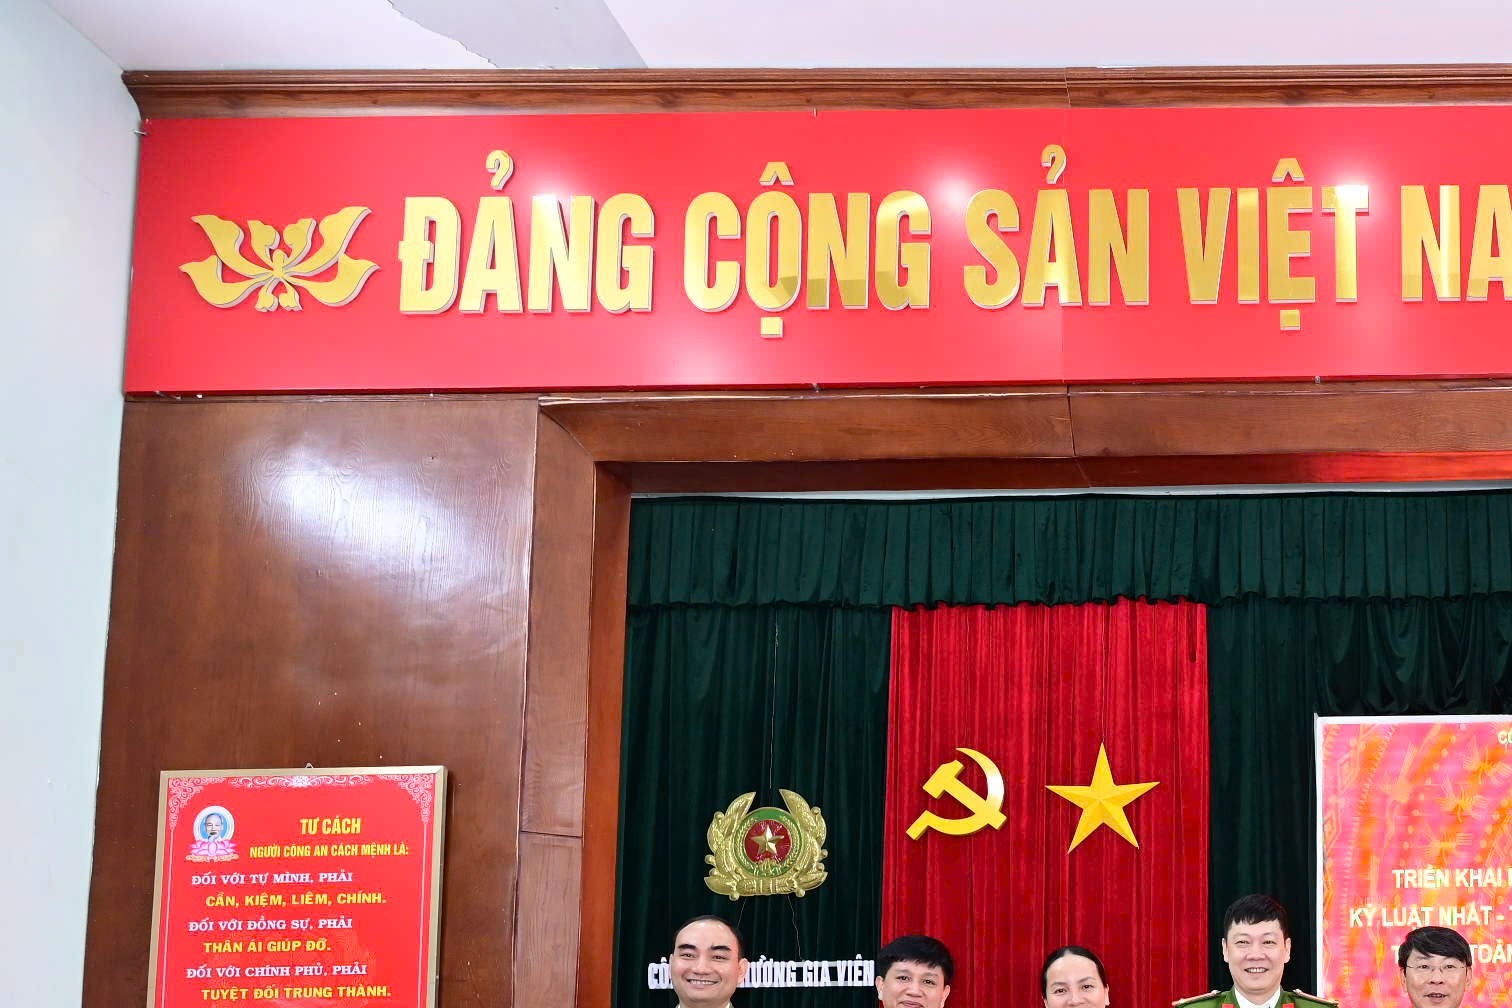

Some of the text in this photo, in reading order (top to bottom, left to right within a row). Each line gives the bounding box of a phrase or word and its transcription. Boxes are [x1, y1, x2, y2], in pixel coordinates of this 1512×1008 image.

[398, 149, 654, 315] ĐẢNG
[684, 161, 931, 337] CỘNG
[963, 143, 1149, 309] SẢN
[1176, 158, 1369, 331] VIỆT
[300, 816, 361, 834] TƯ CÁCH
[250, 842, 408, 857] NGƯỜI CÔNG AN CÁCH MỆNH LÀ:
[192, 872, 216, 884] ĐỐI
[221, 872, 245, 884] VỚI
[250, 873, 269, 885] TỰ
[319, 869, 352, 882] PHẢI
[1455, 867, 1502, 888] KHAI
[206, 890, 386, 908] CẦN, KIỆM, LIÊM, CHÍNH.
[1382, 904, 1433, 930] LUẬT
[204, 938, 330, 952] THÂN ÁI GIÚP ĐỠ.
[803, 959, 831, 987] GIA
[837, 954, 875, 987] VIÊN
[202, 984, 390, 1001] TUYỆT ĐỐI TRUNG THÀNH.
